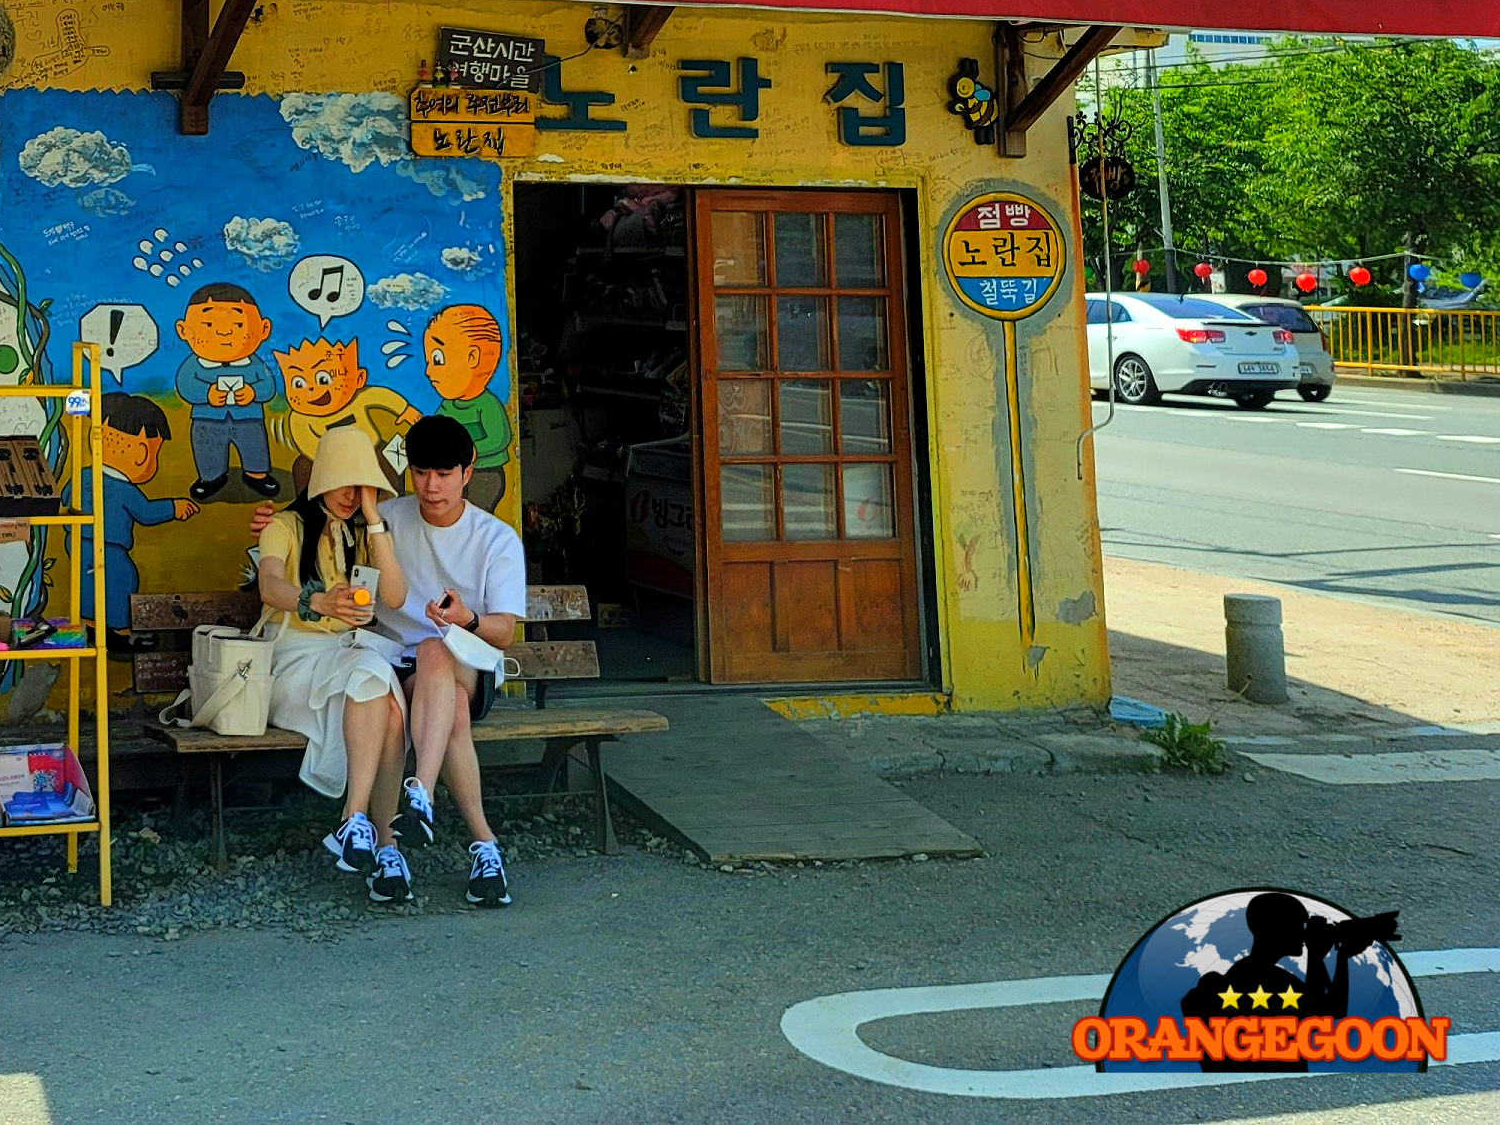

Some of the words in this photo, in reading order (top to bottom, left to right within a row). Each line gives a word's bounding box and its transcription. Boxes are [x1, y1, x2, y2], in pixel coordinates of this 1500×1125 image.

[449, 34, 536, 63] 군산시간
[414, 91, 460, 118] 추억의
[466, 93, 530, 117] 주전부리
[534, 55, 906, 147] 노란집
[433, 127, 506, 156] 노란집
[977, 203, 1031, 230] 점빵
[957, 231, 1052, 268] 노란집
[979, 279, 1038, 306] 철뚝길
